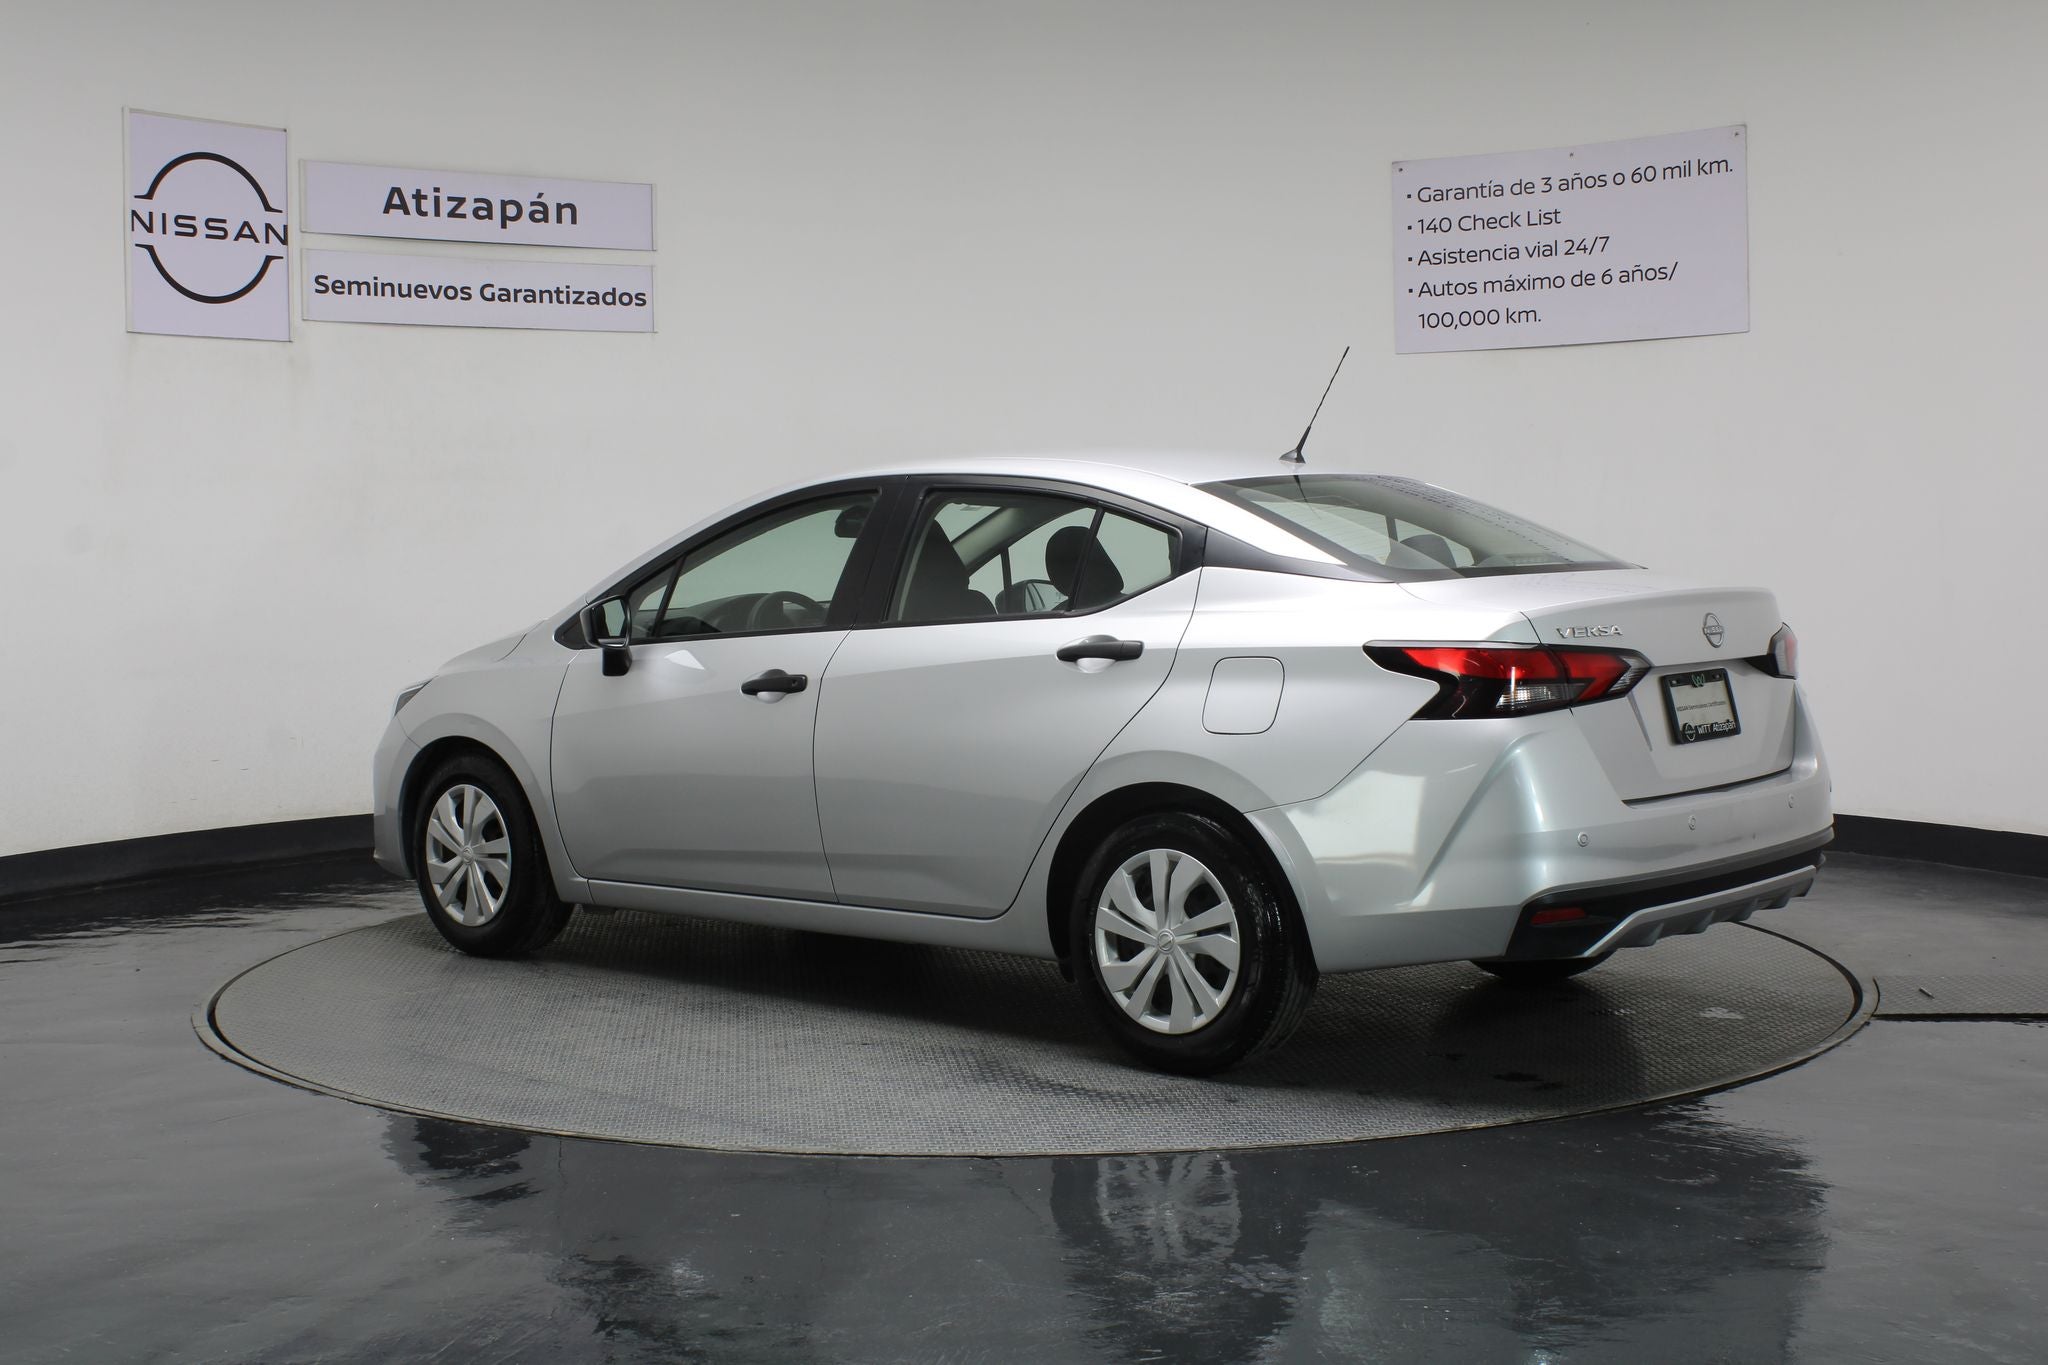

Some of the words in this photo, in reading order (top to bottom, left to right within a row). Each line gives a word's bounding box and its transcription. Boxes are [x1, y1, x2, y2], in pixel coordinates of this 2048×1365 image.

[1417, 179, 1504, 203] Garantía
[1510, 178, 1536, 196] de
[1541, 177, 1553, 194] 3
[1558, 171, 1608, 192] años
[1612, 173, 1626, 186] o
[1631, 166, 1657, 184] 60
[1662, 159, 1693, 181] mil
[1697, 157, 1734, 176] km.
[383, 187, 578, 229] Atizapán
[1417, 215, 1453, 234] 140
[1457, 210, 1522, 232] Check
[1526, 208, 1562, 227] List
[131, 210, 288, 246] NISSAN
[1417, 243, 1521, 267] Asistencia
[1525, 240, 1558, 260] vial
[1563, 235, 1610, 257] 24/7
[314, 274, 473, 302] Seminuevos
[479, 283, 647, 308] Garantizados
[1417, 279, 1478, 298] Autos
[1483, 273, 1566, 294] máximo
[1570, 269, 1596, 288] de
[1601, 268, 1613, 285] 6
[1618, 262, 1679, 284] años/
[1417, 308, 1500, 330] 100,000
[1506, 307, 1542, 324] km.
[1556, 624, 1623, 639] VERSA
